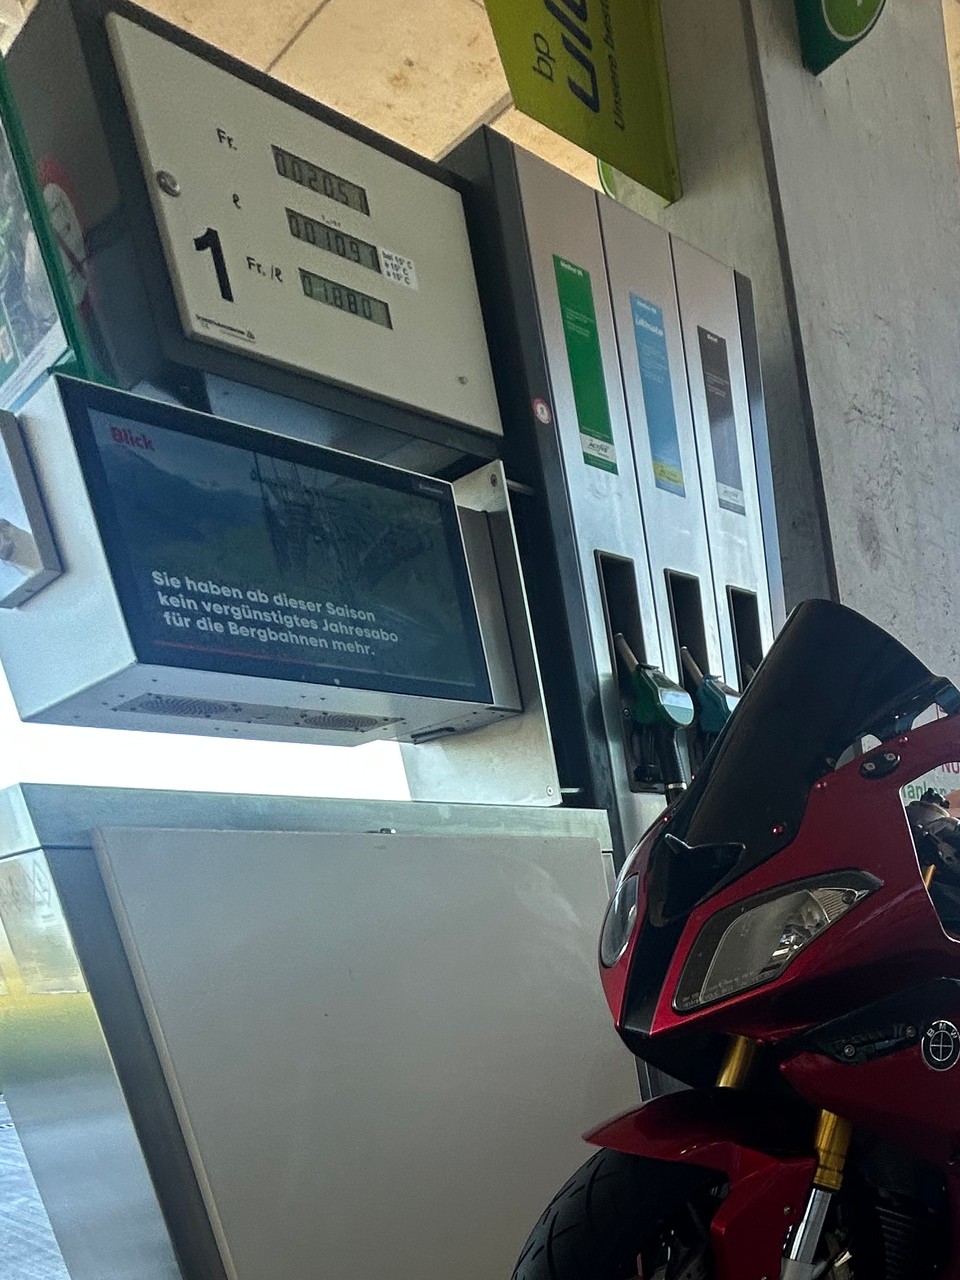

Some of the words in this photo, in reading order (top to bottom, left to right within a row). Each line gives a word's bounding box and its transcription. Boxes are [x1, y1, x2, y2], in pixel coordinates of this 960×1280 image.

[532, 32, 556, 82] bp
[216, 128, 238, 151] Fr.
[193, 226, 235, 303] 1
[111, 426, 155, 452] Blick
[152, 570, 181, 588] Sie
[185, 576, 243, 599] haben
[246, 589, 269, 603] ab
[273, 592, 322, 613] dieser
[325, 602, 376, 622] Saison
[158, 591, 199, 611] kein
[201, 601, 319, 629] vergünstigtes
[322, 618, 399, 642] Jahresabo
[163, 611, 191, 628] für
[196, 617, 225, 633] die
[227, 621, 329, 648] Bergbahnen
[331, 640, 376, 656] mehr.
[926, 1022, 958, 1040] BMW
